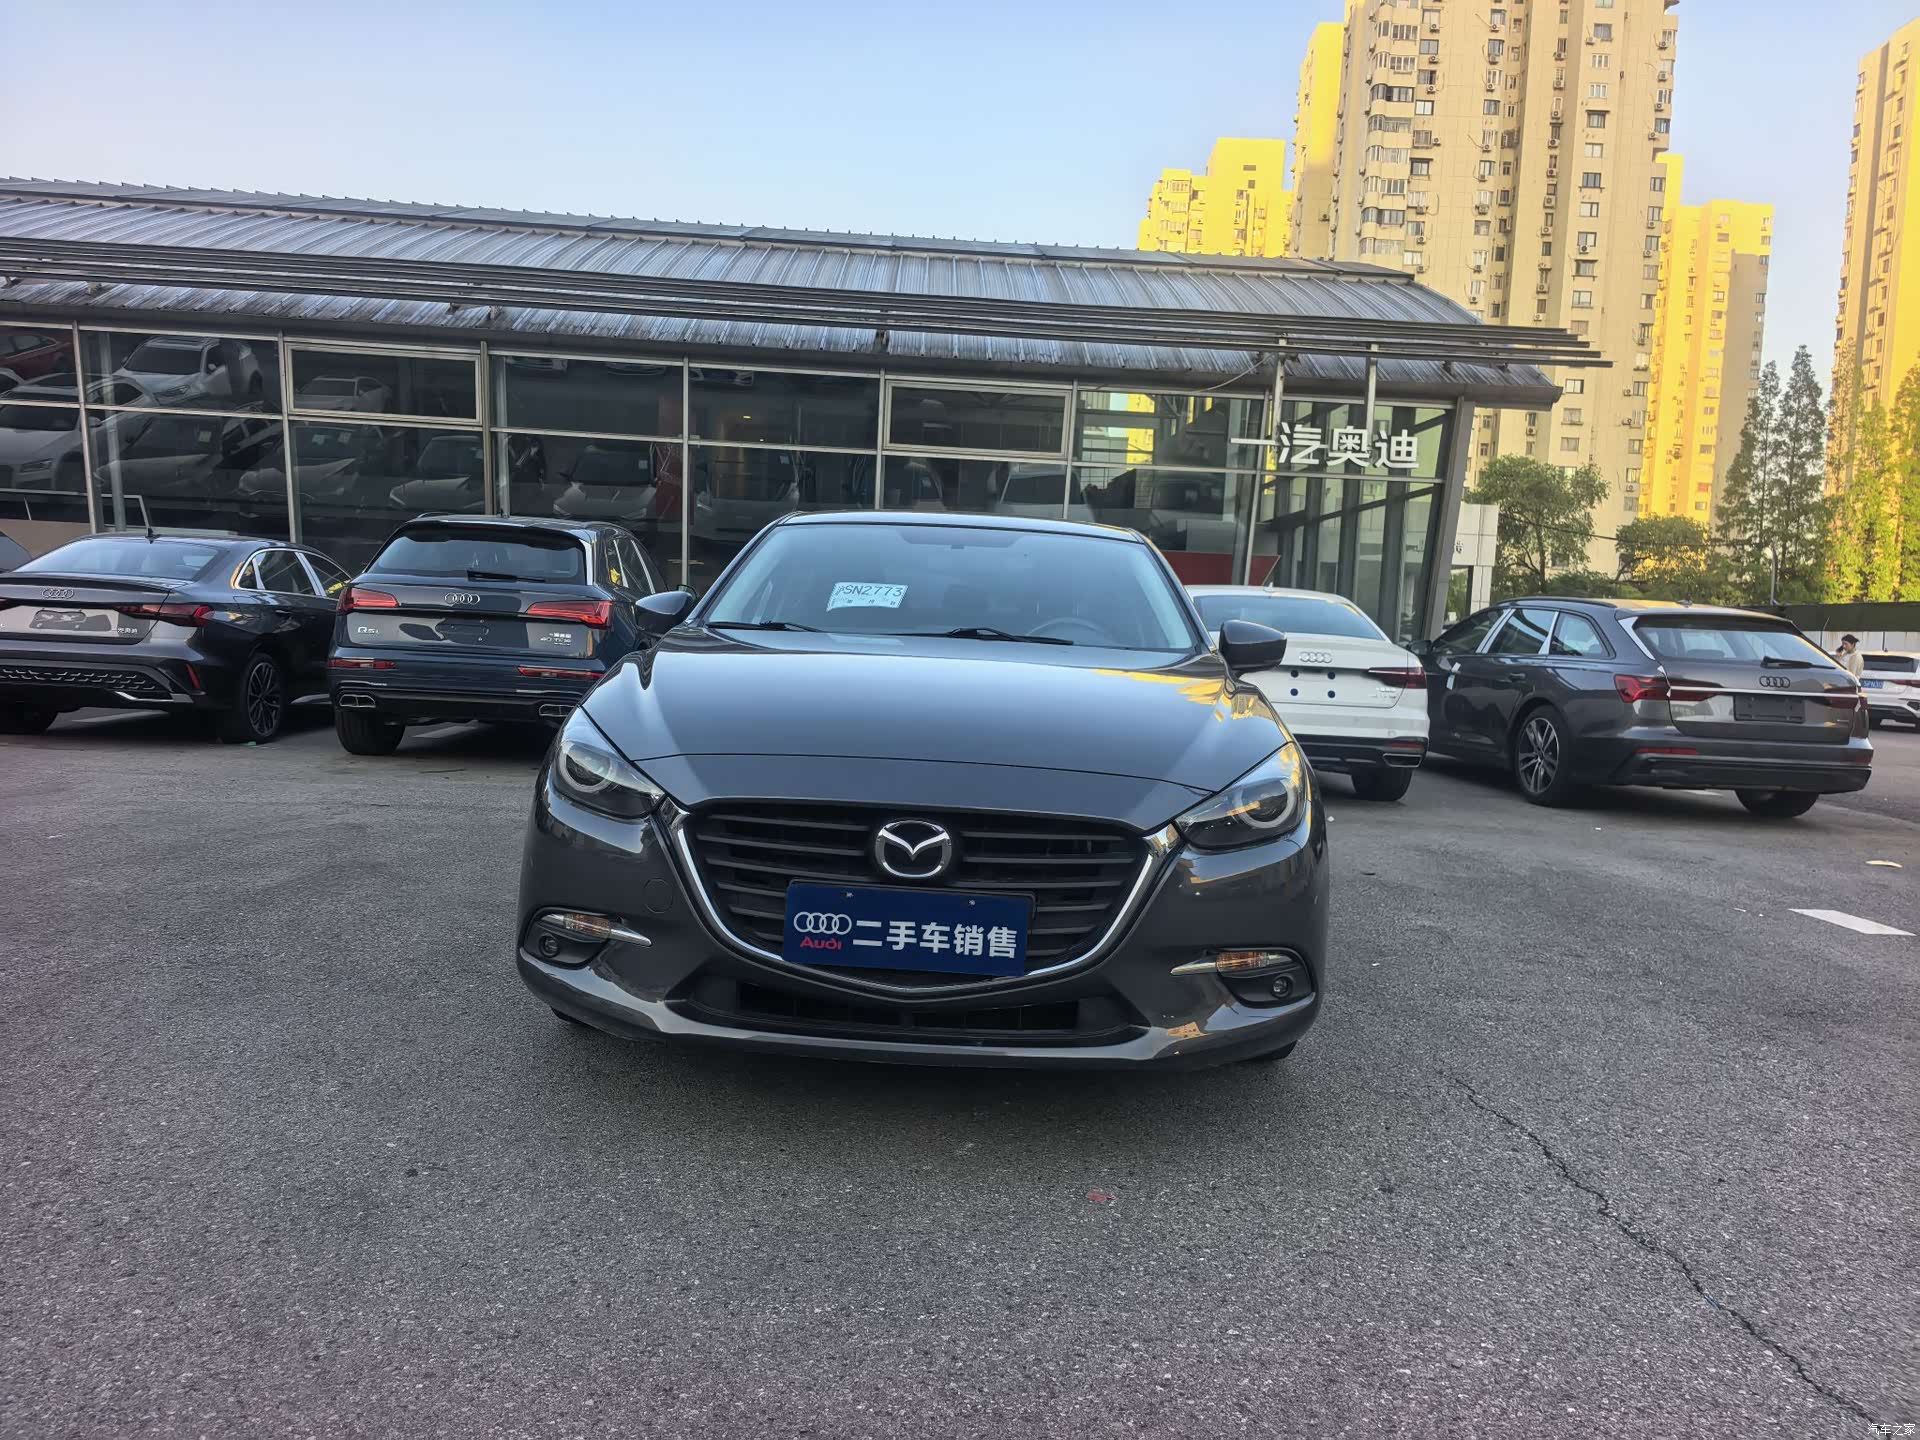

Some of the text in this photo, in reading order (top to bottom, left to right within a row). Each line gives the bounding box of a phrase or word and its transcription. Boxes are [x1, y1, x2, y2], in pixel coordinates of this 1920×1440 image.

[1230, 421, 1420, 469] 一汽奥迪
[800, 935, 843, 951] Audi
[852, 920, 1018, 959] 二手车销售
